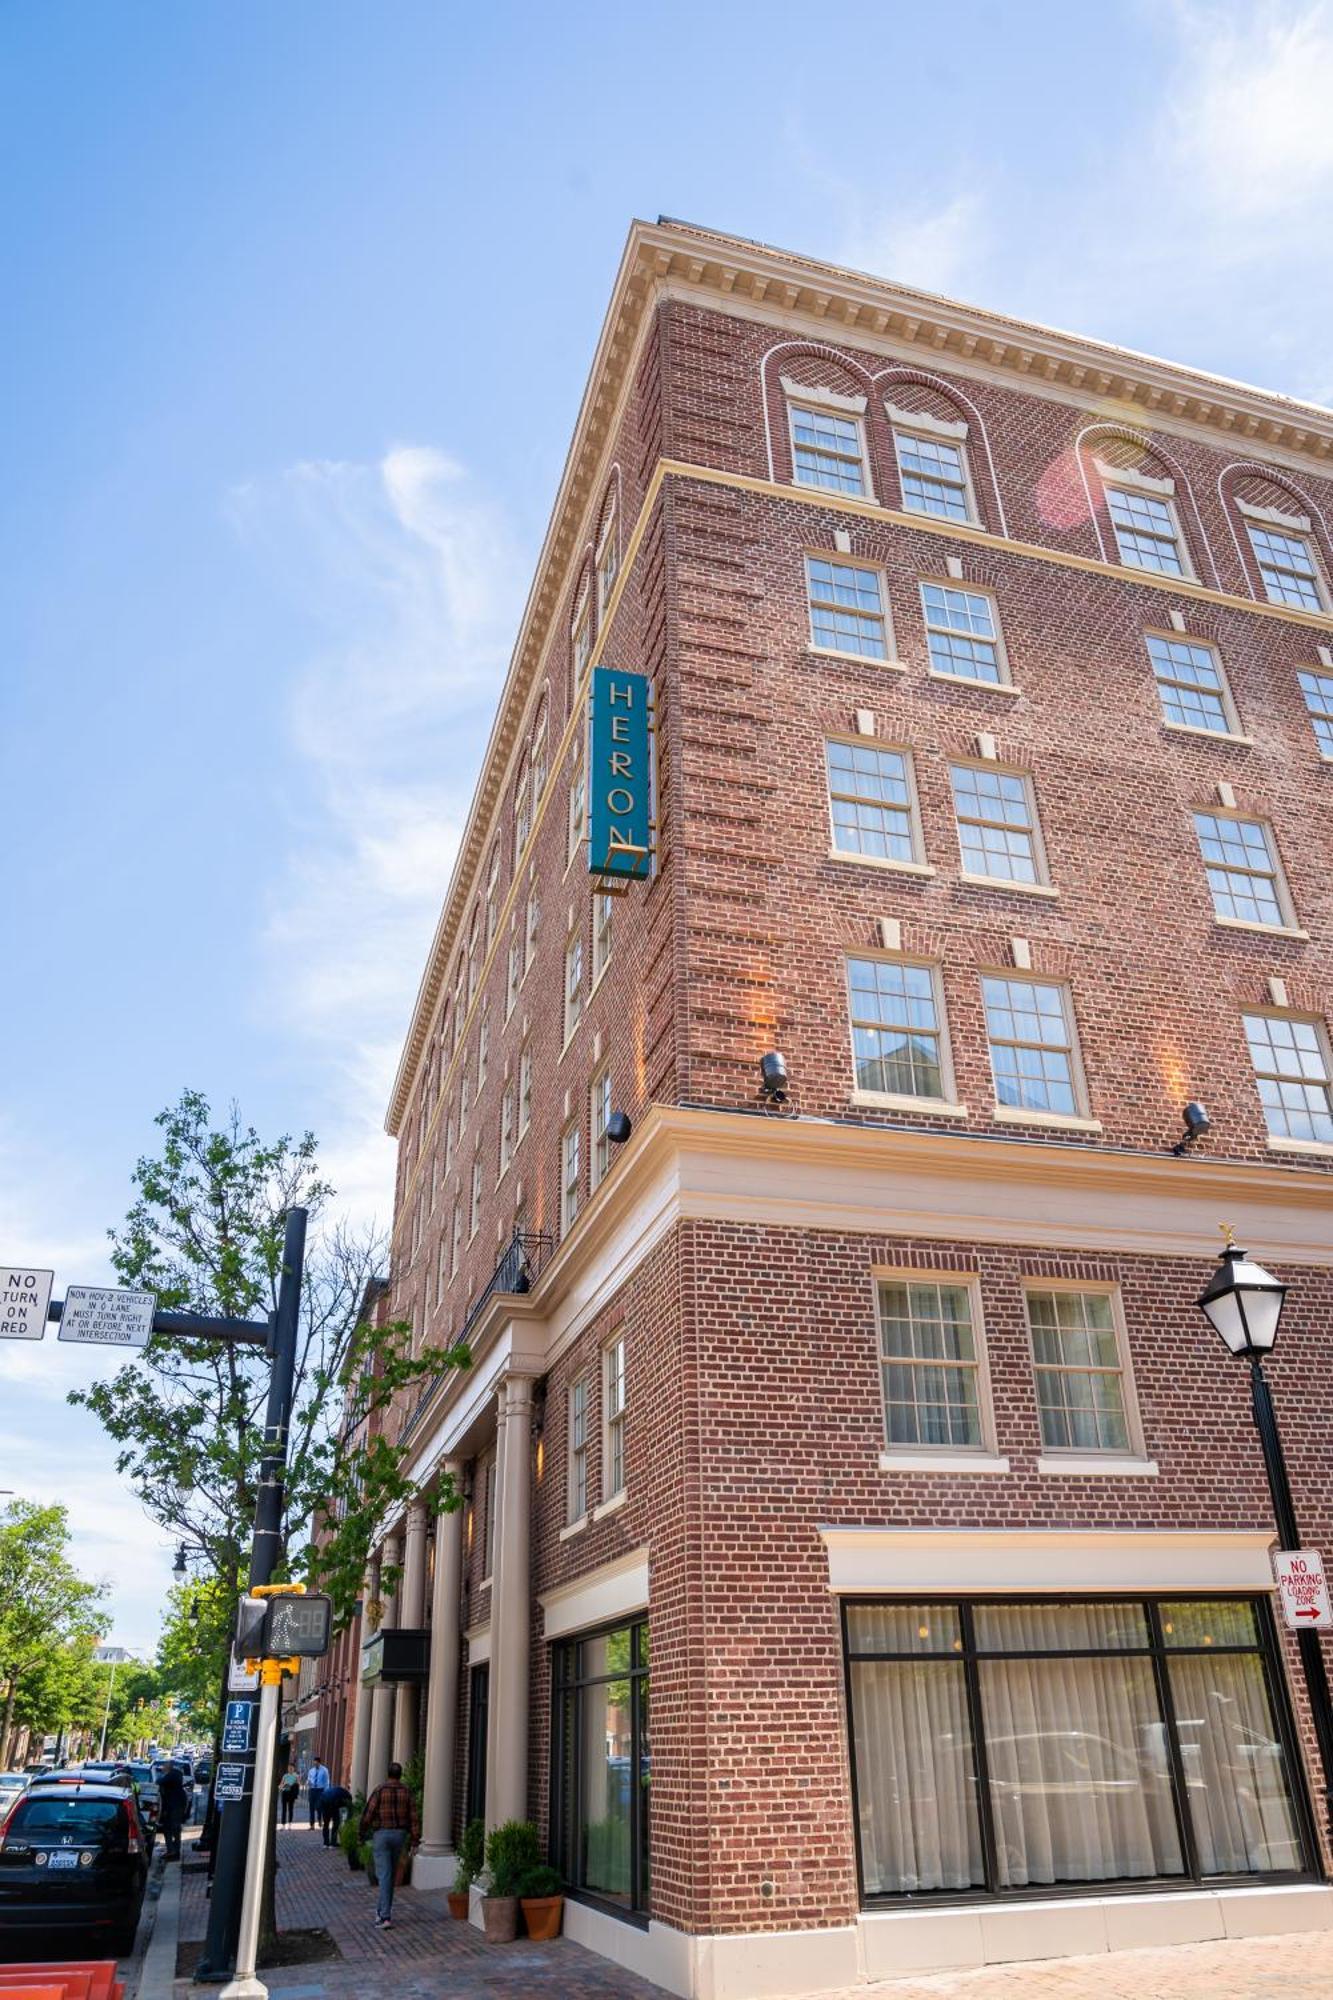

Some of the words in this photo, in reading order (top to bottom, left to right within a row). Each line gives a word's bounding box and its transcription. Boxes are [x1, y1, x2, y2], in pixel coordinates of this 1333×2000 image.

[607, 682, 635, 846] HERON
[8, 1274, 36, 1289] NO
[2, 1291, 38, 1304] TURN
[69, 1290, 86, 1299] NON
[89, 1292, 114, 1301] HOV-2
[117, 1294, 153, 1305] VEHICLES
[7, 1306, 28, 1318] ON
[88, 1302, 97, 1310] IN
[111, 1304, 131, 1313] LANE
[72, 1310, 93, 1319] MUST
[97, 1311, 117, 1321] TURN
[120, 1313, 143, 1323] RIGHT
[0, 1321, 28, 1334] RED
[66, 1320, 75, 1328] AT
[78, 1320, 90, 1329] OR
[92, 1321, 124, 1331] BEFORE
[126, 1323, 146, 1333] NEXT
[77, 1329, 132, 1341] INTERSECTION
[1290, 1560, 1307, 1573] NO
[1280, 1574, 1323, 1586] PARKING
[1287, 1585, 1321, 1596] LOADING
[1295, 1595, 1317, 1606] ZONE
